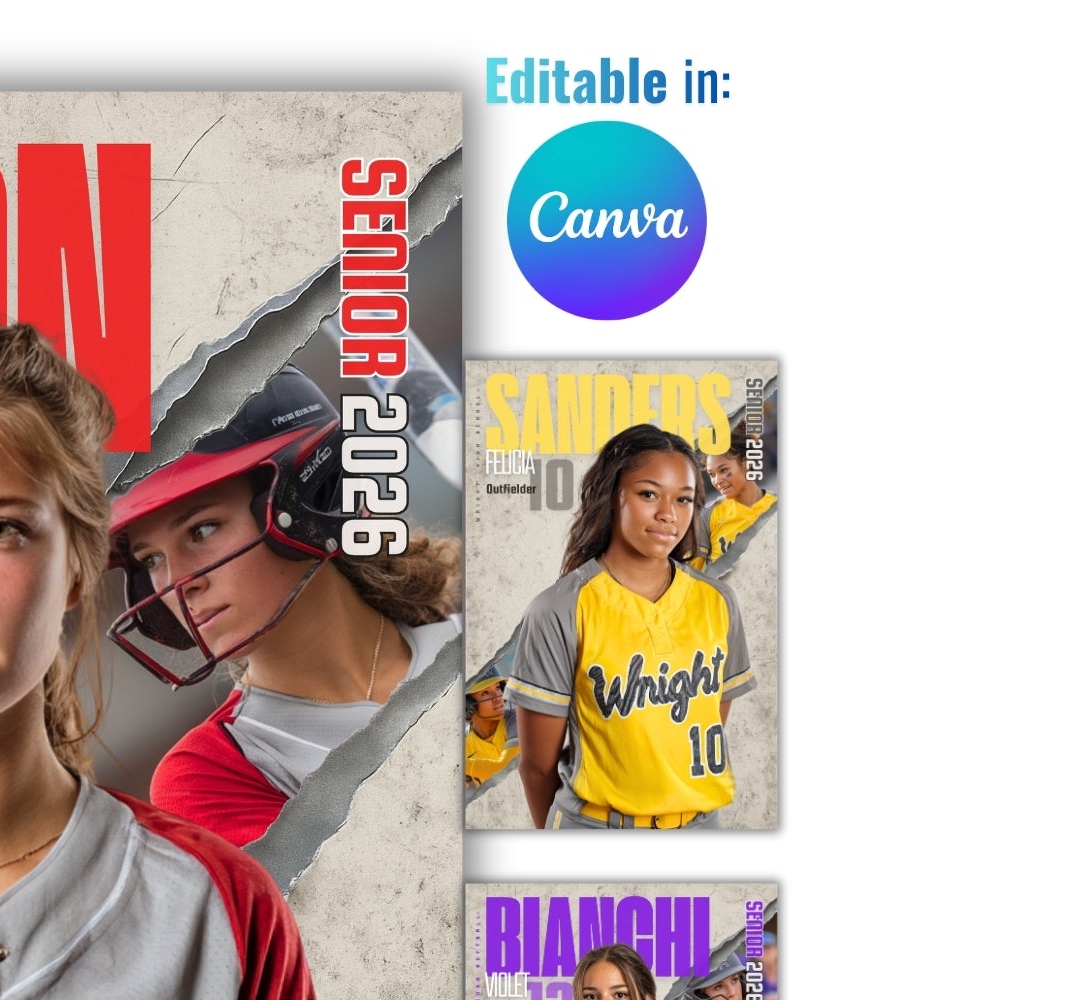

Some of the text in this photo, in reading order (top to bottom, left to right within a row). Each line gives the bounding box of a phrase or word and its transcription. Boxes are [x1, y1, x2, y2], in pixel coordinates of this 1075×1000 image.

[340, 157, 410, 556] SENIOR 2026
[485, 371, 731, 456] SANDERS
[745, 377, 764, 481] SENIOR 2026
[485, 448, 536, 475] FELICIA
[486, 483, 537, 495] Outfielder
[527, 458, 574, 511] 10
[587, 645, 725, 724] Wright
[688, 723, 727, 779] 10
[485, 895, 710, 978] BIANCHI
[745, 900, 764, 958] SENIOR
[485, 971, 531, 998] VIOLET
